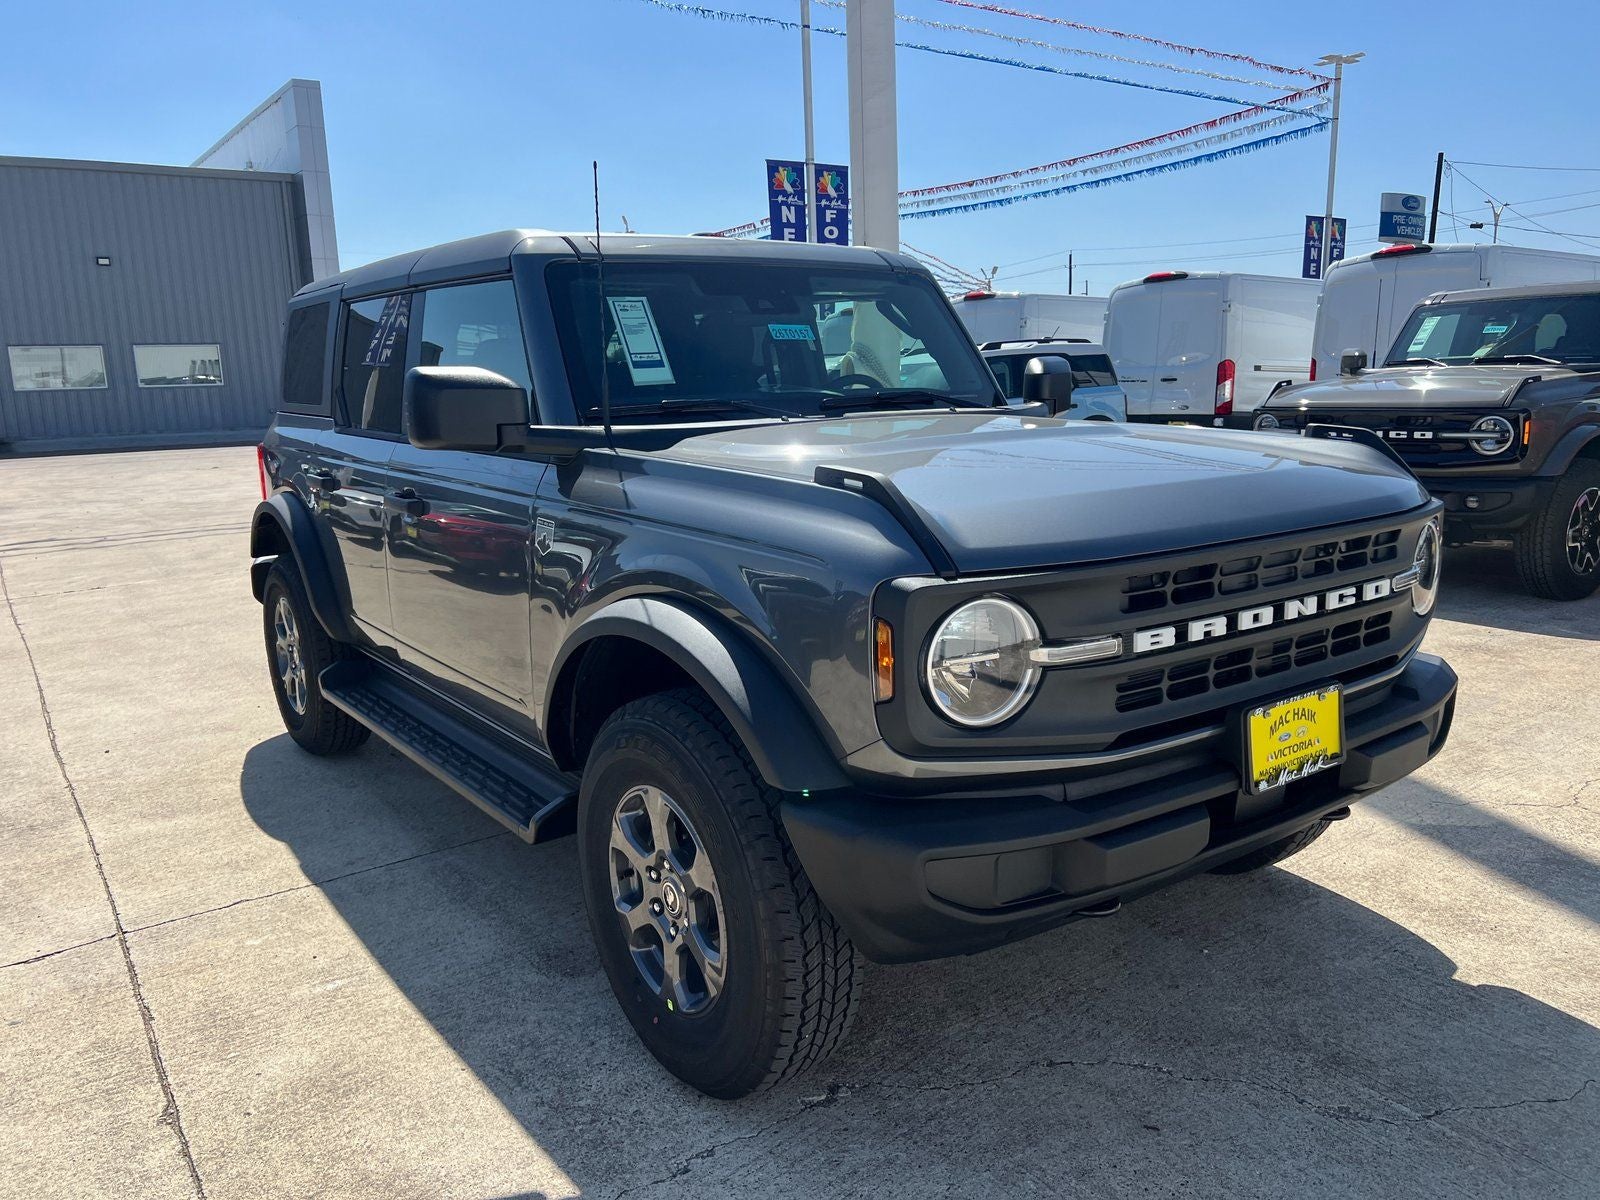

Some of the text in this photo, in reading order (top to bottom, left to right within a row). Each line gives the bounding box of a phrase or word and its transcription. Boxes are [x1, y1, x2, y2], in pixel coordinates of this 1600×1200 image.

[1132, 578, 1391, 653] BRONCO
[1269, 710, 1290, 739] MAC
[1293, 707, 1318, 725] HAIK
[1273, 738, 1314, 760] VICTORIA
[1276, 767, 1302, 787] Mac
